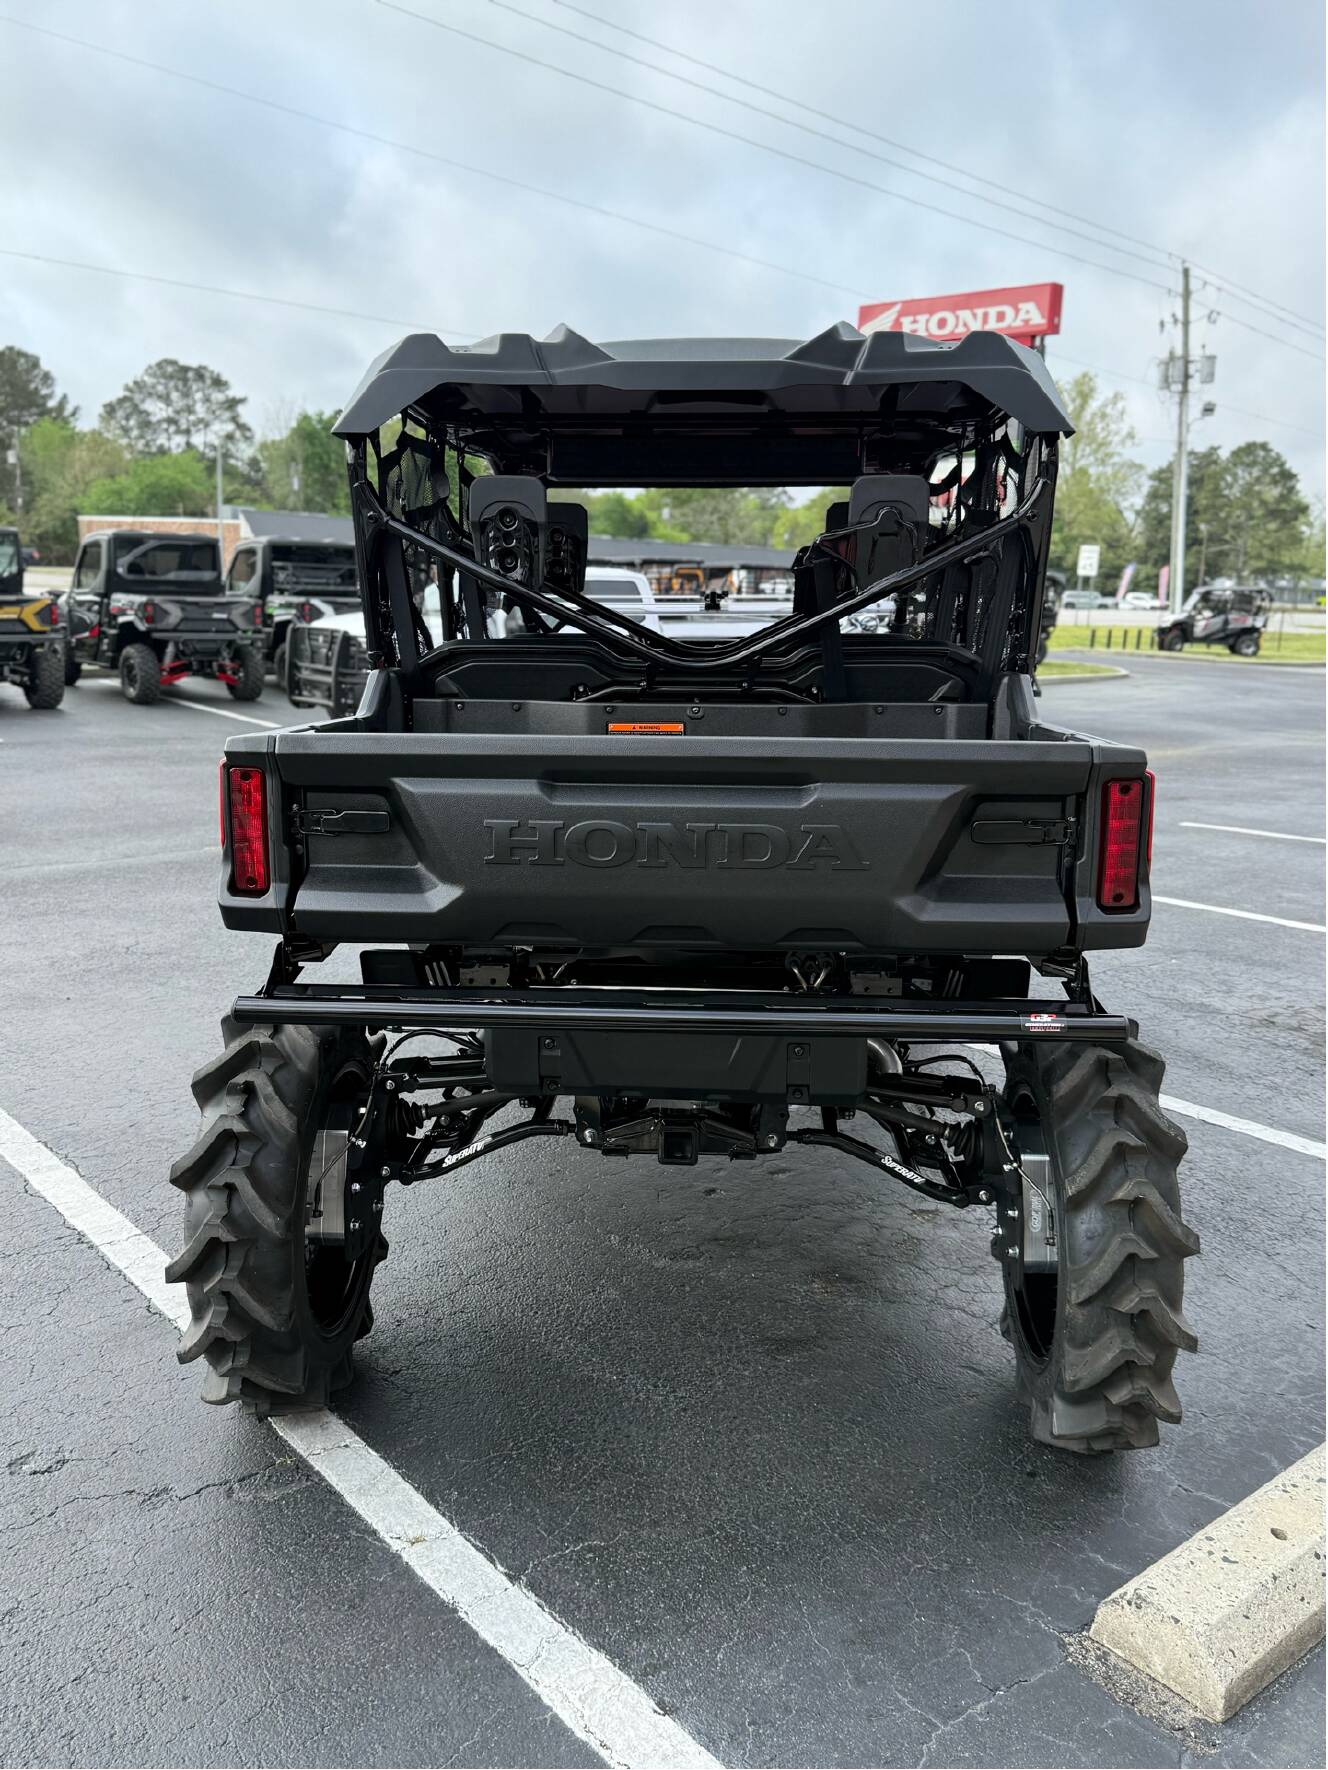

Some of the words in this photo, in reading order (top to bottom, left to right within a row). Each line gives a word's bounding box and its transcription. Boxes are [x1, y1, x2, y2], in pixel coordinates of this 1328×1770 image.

[900, 301, 1046, 337] HONDA
[483, 819, 871, 870] HONDA
[881, 1155, 925, 1183] SUPERATV
